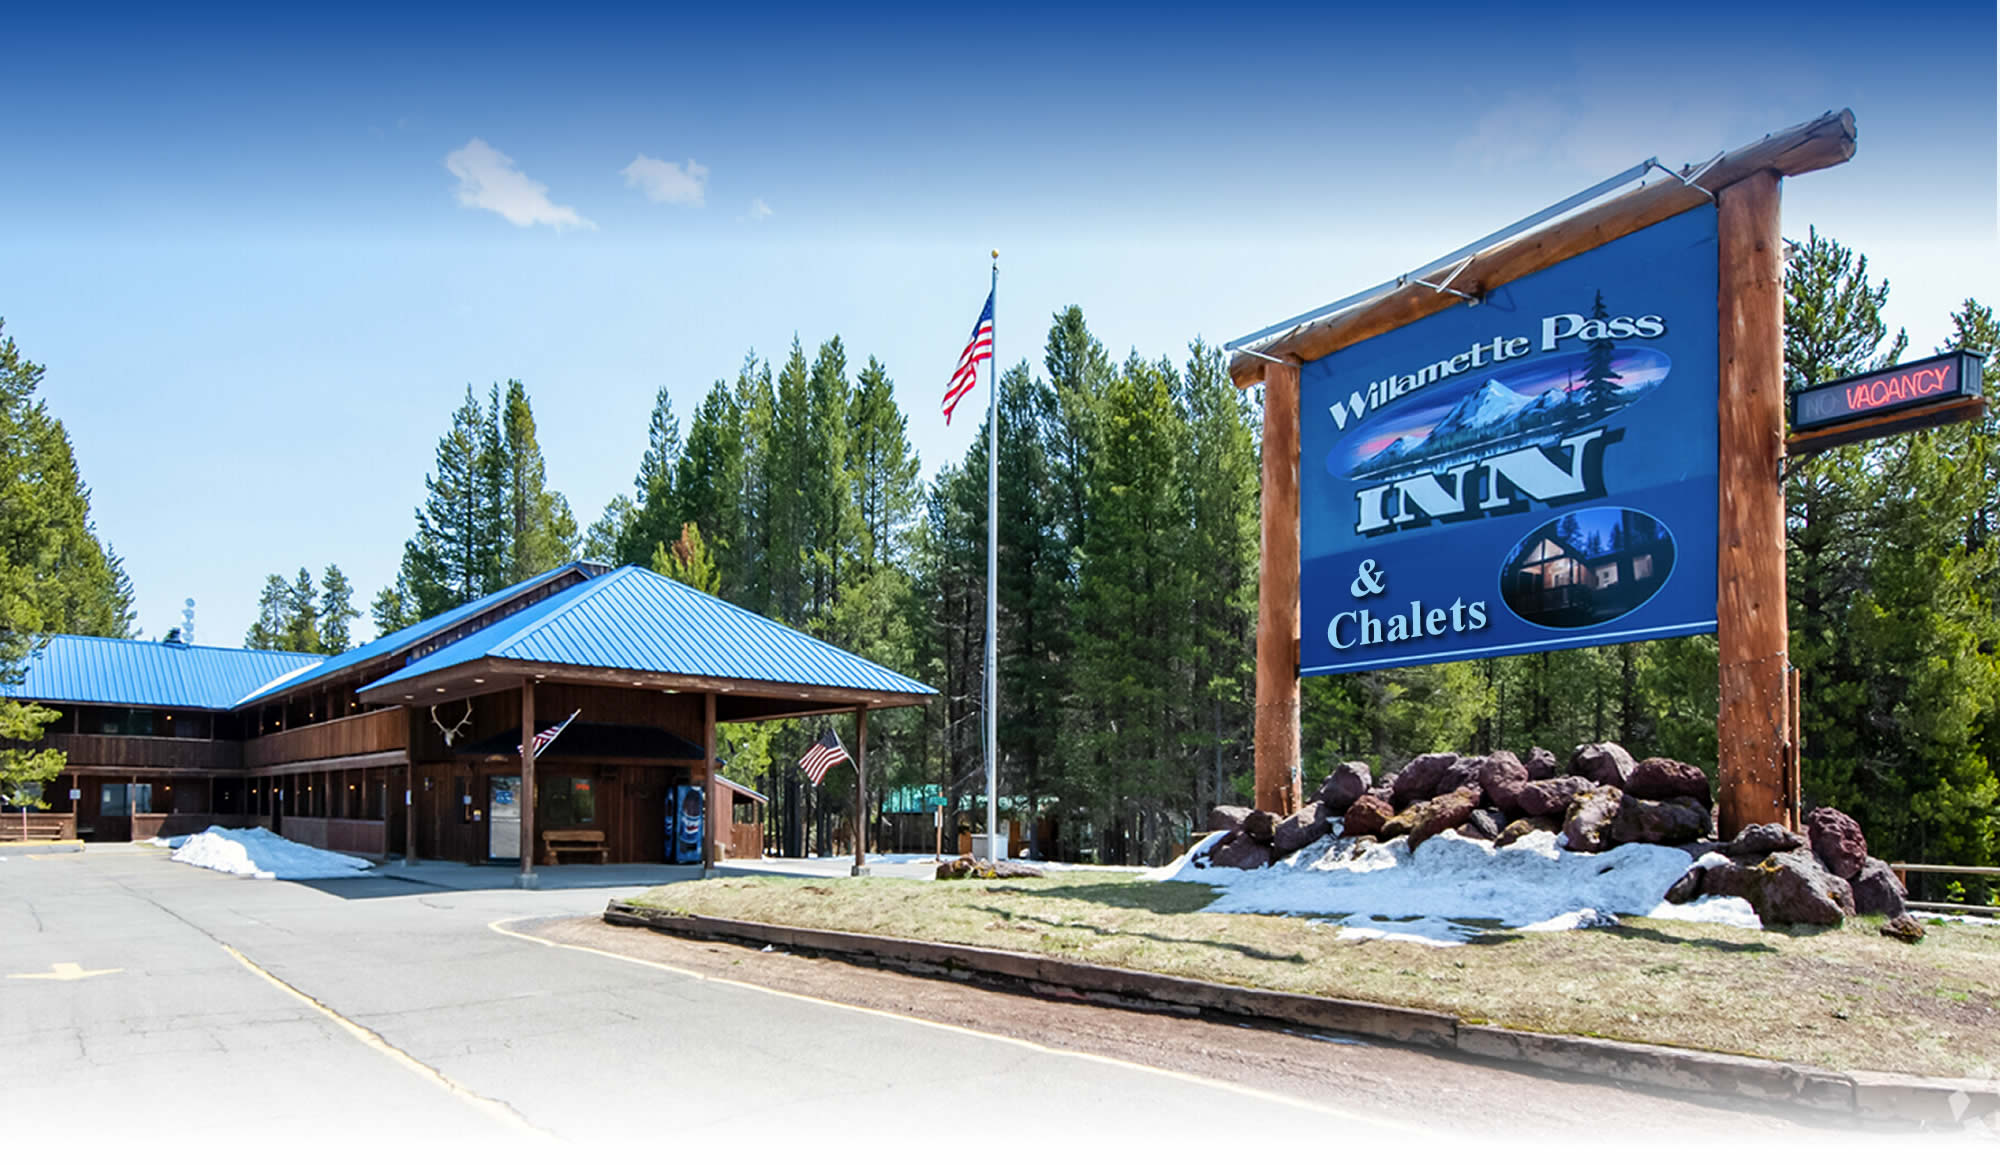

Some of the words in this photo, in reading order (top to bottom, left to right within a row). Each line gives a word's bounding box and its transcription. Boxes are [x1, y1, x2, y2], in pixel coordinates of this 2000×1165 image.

[1328, 335, 1529, 431] Willamette
[1541, 313, 1665, 351] Pass
[1846, 365, 1950, 409] VACANCY
[1356, 429, 1604, 533] INN
[1350, 557, 1385, 598] &
[1327, 597, 1487, 650] Chalets
